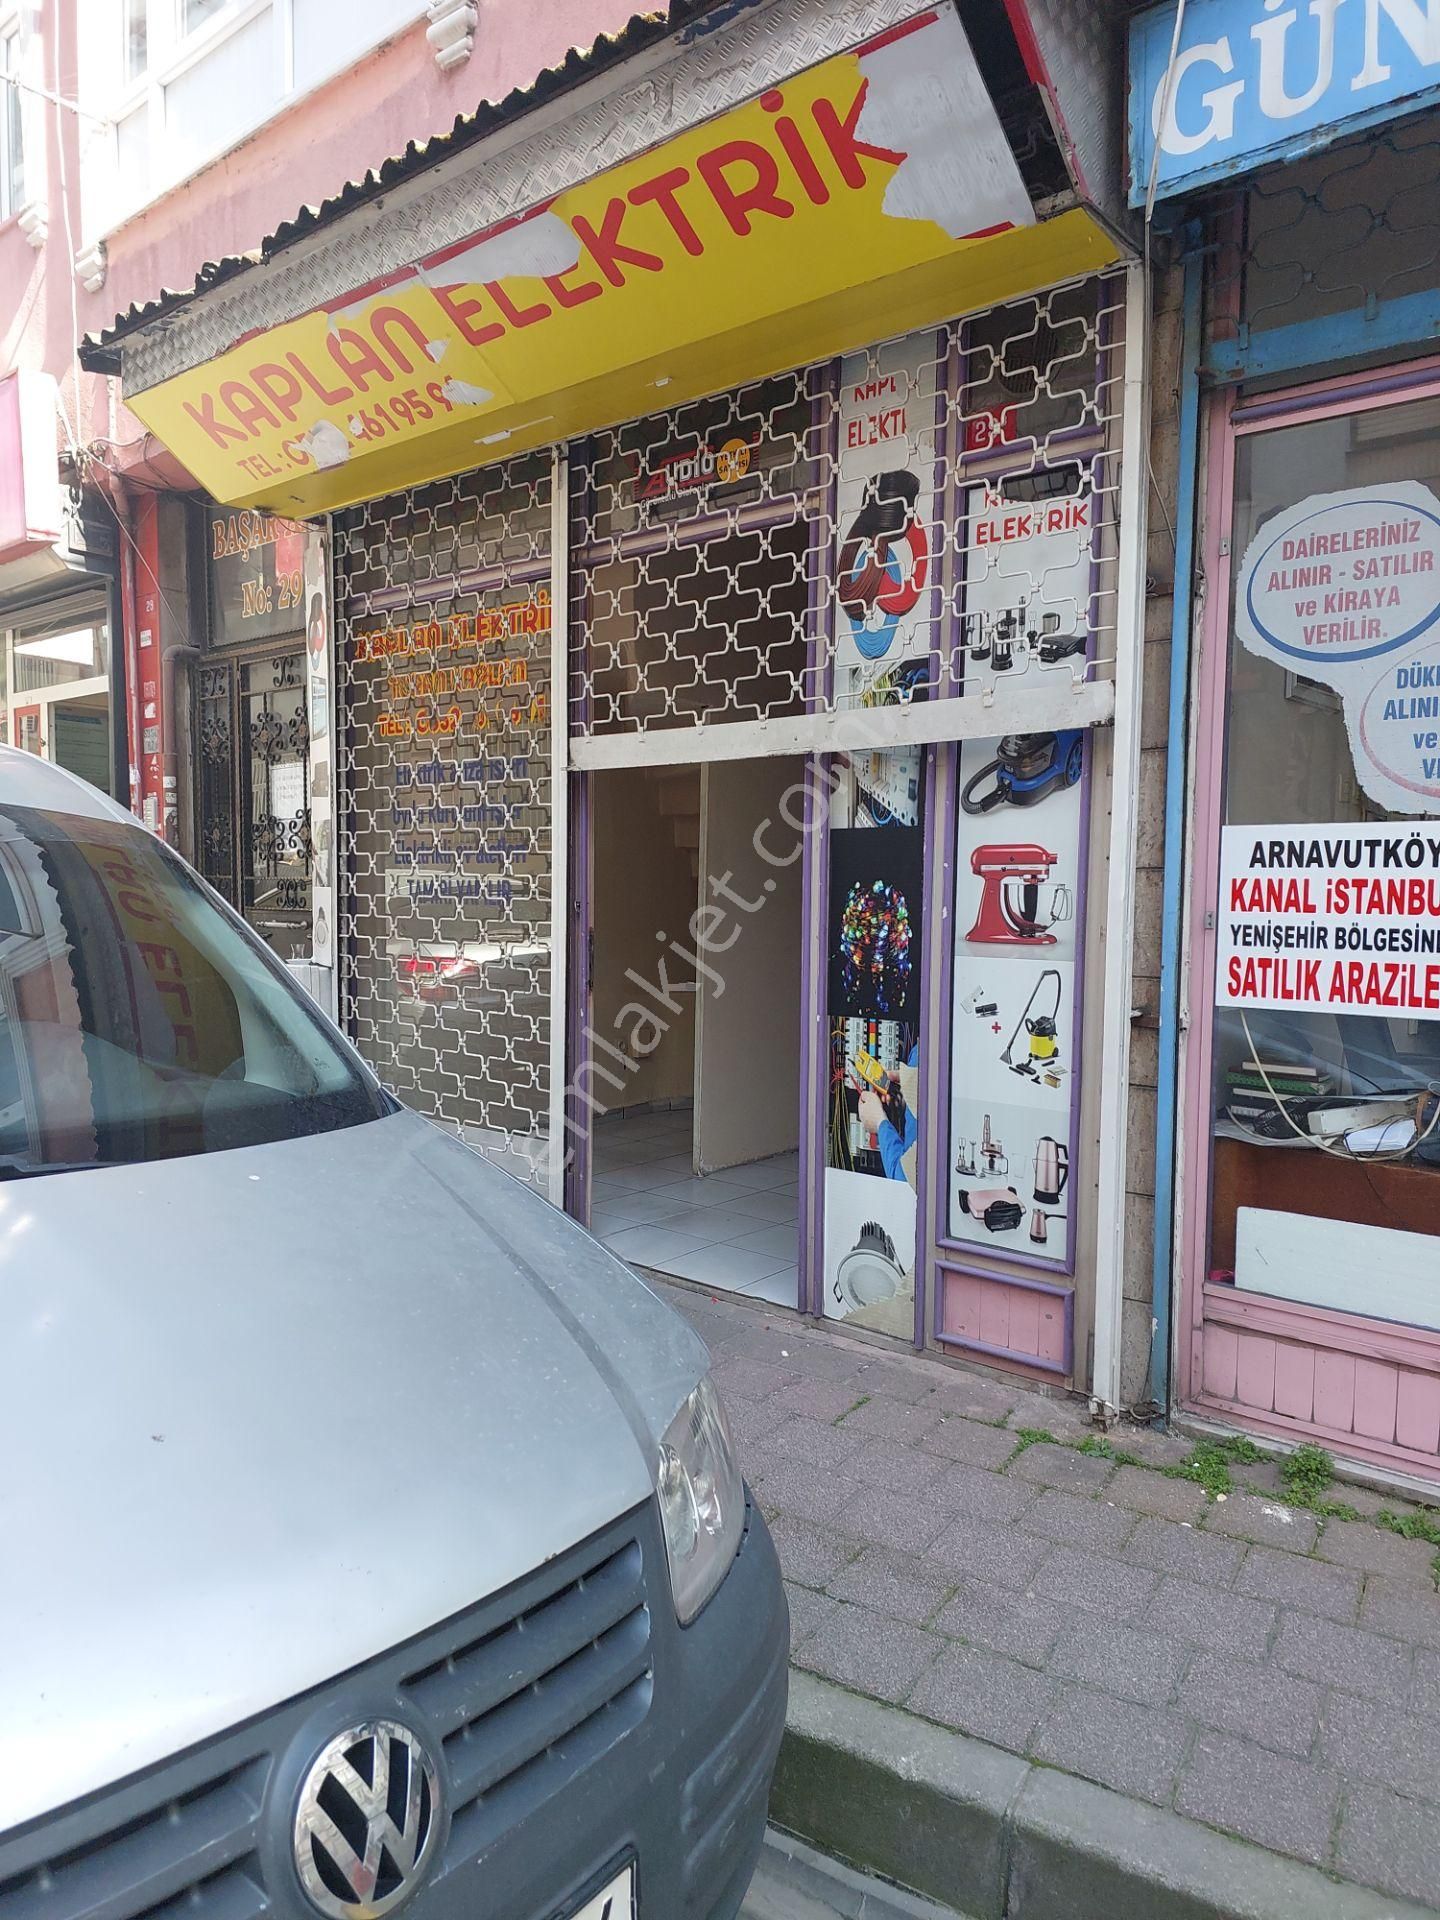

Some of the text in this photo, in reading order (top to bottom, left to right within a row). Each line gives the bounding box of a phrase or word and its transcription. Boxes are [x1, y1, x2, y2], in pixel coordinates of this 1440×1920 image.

[183, 77, 908, 450] KAPLAN ELEKTRİK
[1281, 518, 1421, 561] DAİRELERİNİZ
[1267, 564, 1332, 592] ALINIR
[1352, 550, 1434, 581] SATILIR
[241, 569, 304, 618] No: 29
[1295, 585, 1401, 618] ve KİRAYA
[1303, 615, 1388, 646] VERİLİR.
[1396, 662, 1440, 689] DÜK
[1413, 732, 1438, 749] ve
[1422, 758, 1440, 779] V
[1249, 832, 1440, 868] ARNAVUTKÖY
[1230, 877, 1317, 914] KANAL
[1230, 919, 1440, 953] YENİŞEHİR BÖLGESİN
[1227, 955, 1322, 1002] SATILIK
